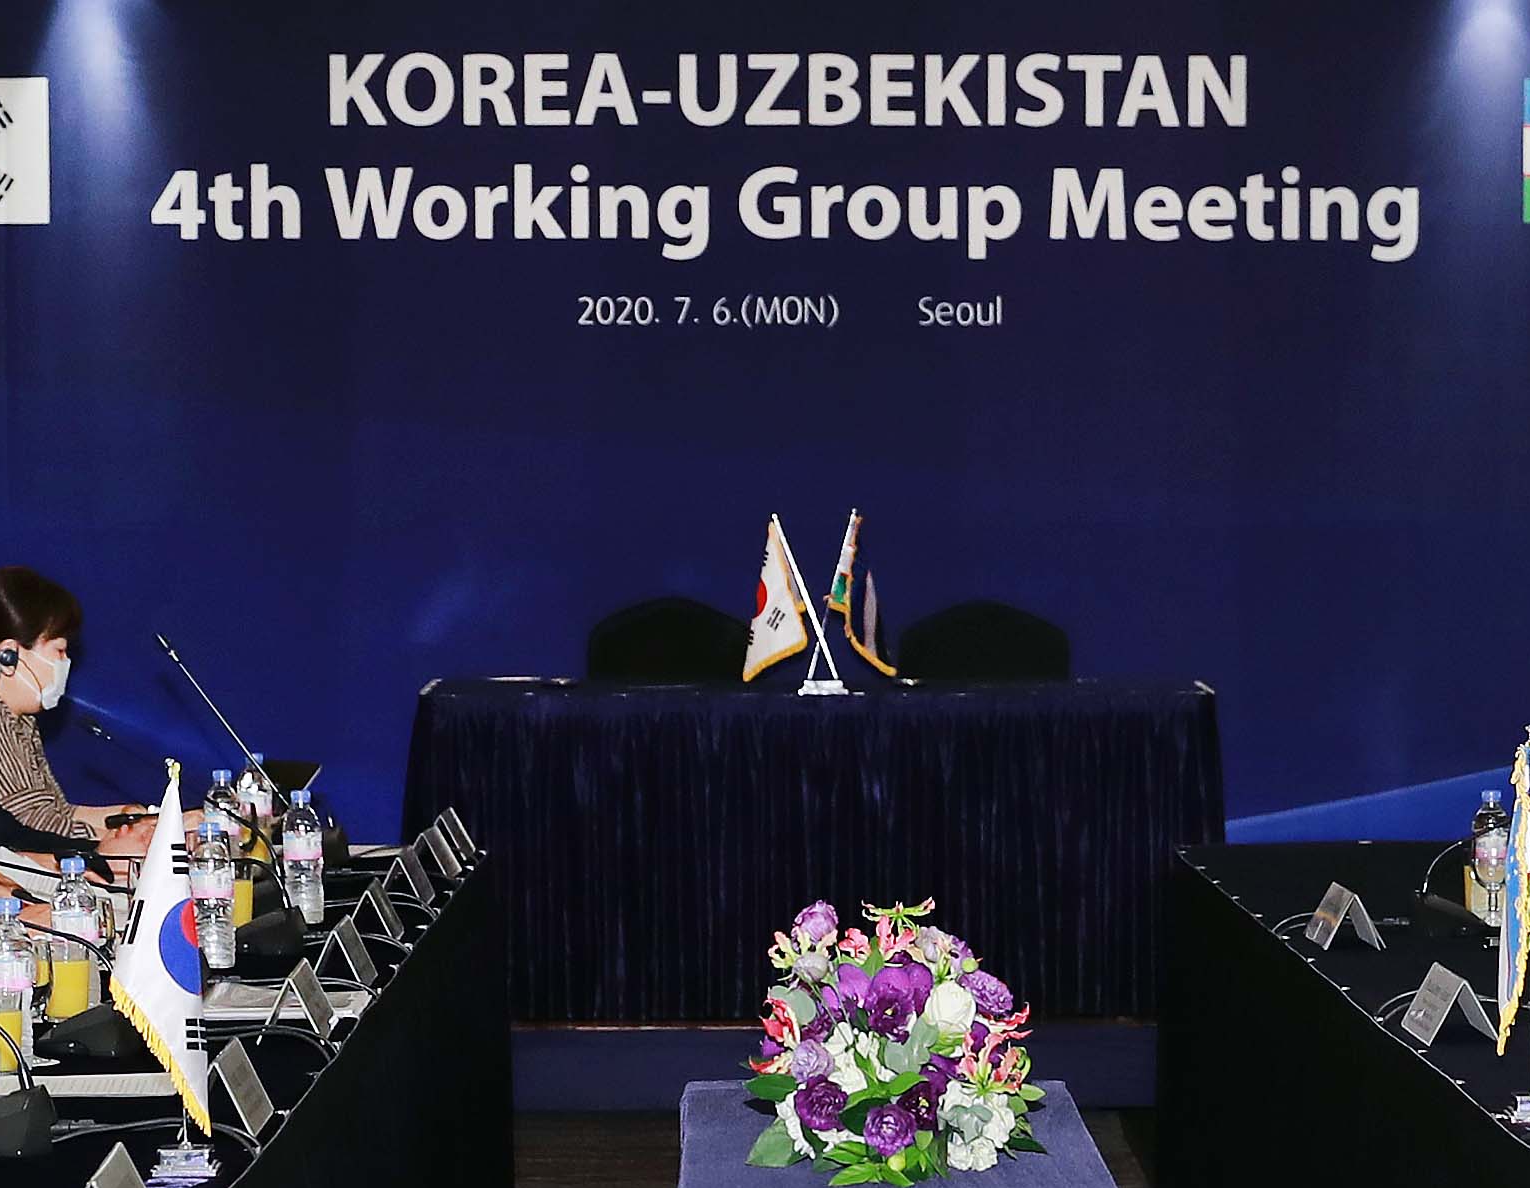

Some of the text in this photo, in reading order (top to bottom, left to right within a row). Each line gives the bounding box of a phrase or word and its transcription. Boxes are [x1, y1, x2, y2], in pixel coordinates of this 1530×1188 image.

[328, 52, 1248, 128] KOREA-UZBEKISTAN
[151, 163, 1421, 262] 4th Working Group Meeting
[577, 295, 660, 326] 2020.
[673, 296, 700, 325] 7.
[918, 295, 1003, 327] Seoul
